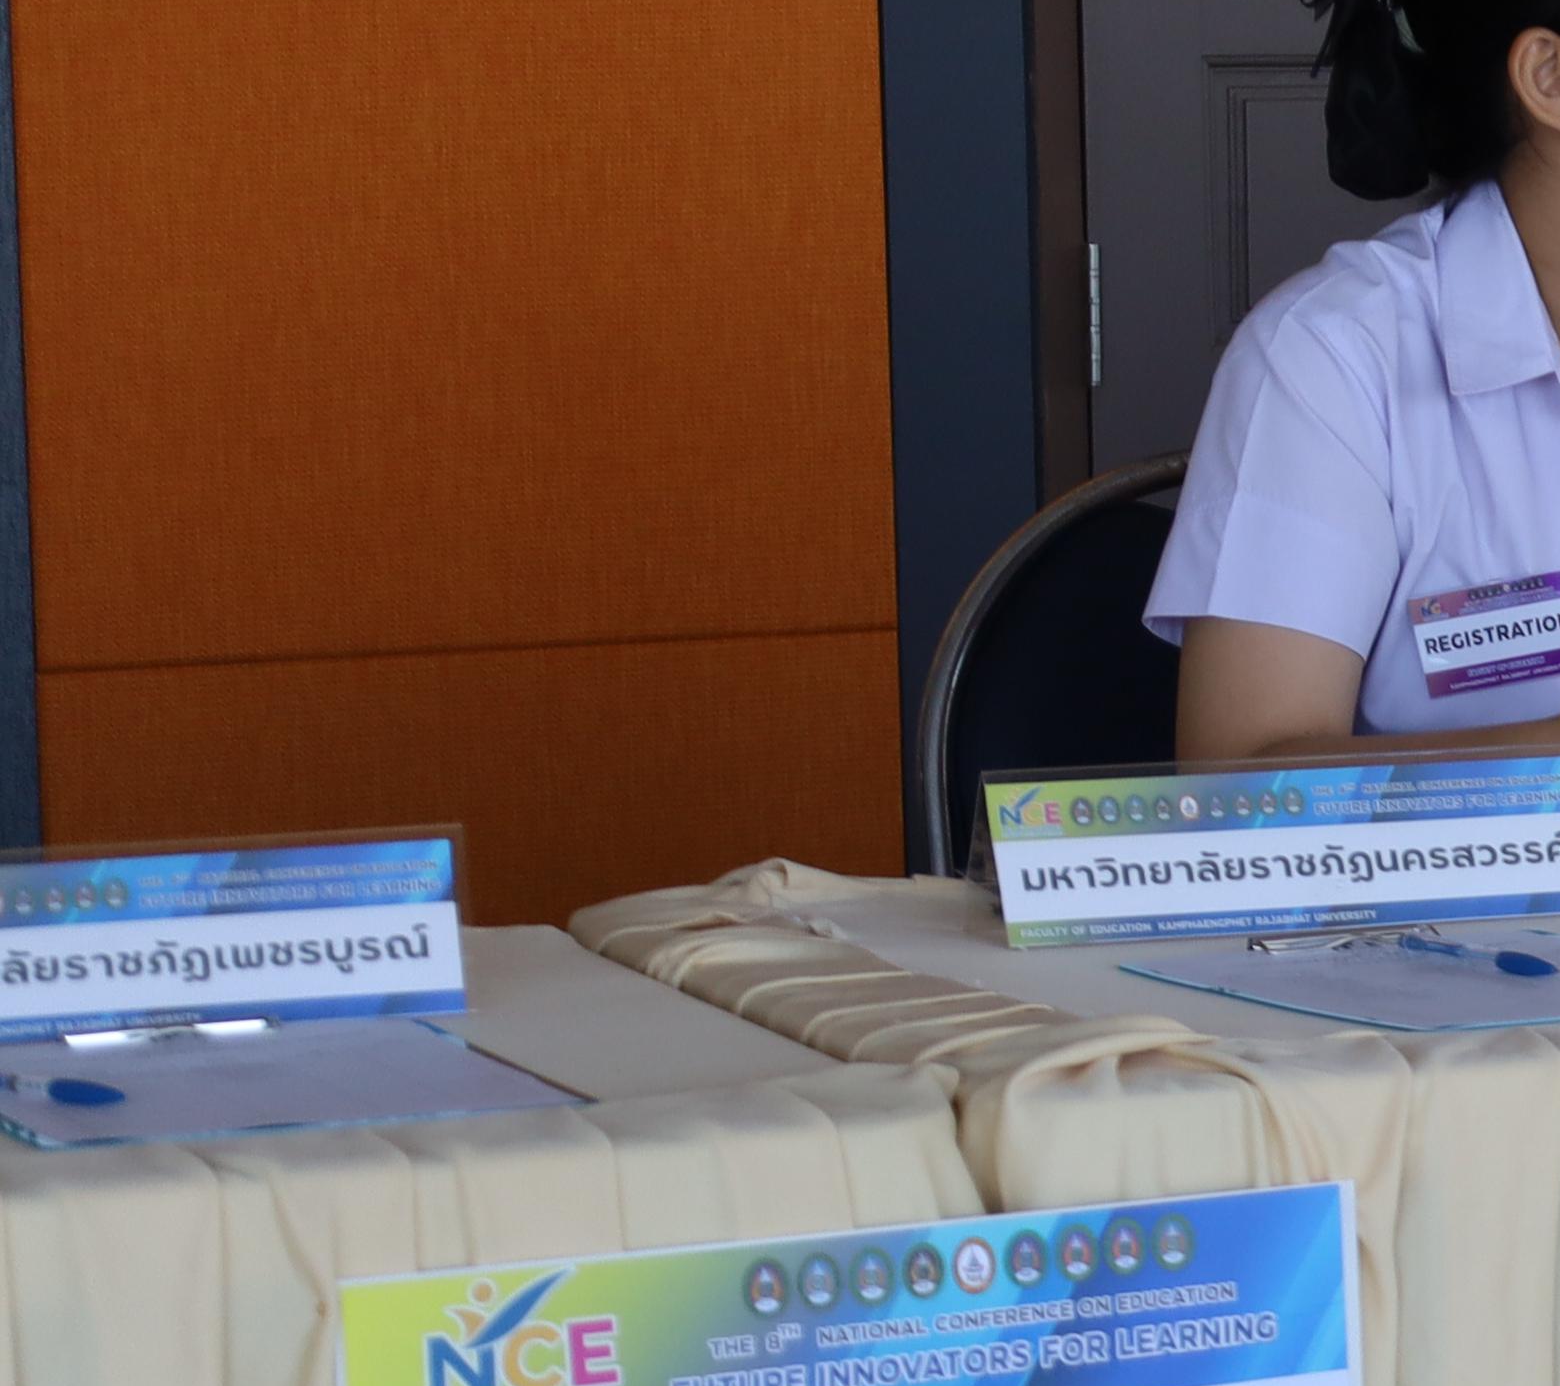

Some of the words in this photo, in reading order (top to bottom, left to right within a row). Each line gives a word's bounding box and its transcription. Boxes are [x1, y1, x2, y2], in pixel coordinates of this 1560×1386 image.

[998, 803, 1063, 827] NCE
[709, 1336, 754, 1359] THE
[817, 1319, 926, 1346] NATIONAL
[935, 1303, 1072, 1332] CONFERENCE
[1077, 1296, 1112, 1315] ON
[1117, 1282, 1237, 1312] EDUCATION
[1041, 1328, 1106, 1366] FOR
[1114, 1312, 1278, 1358] LEARNING
